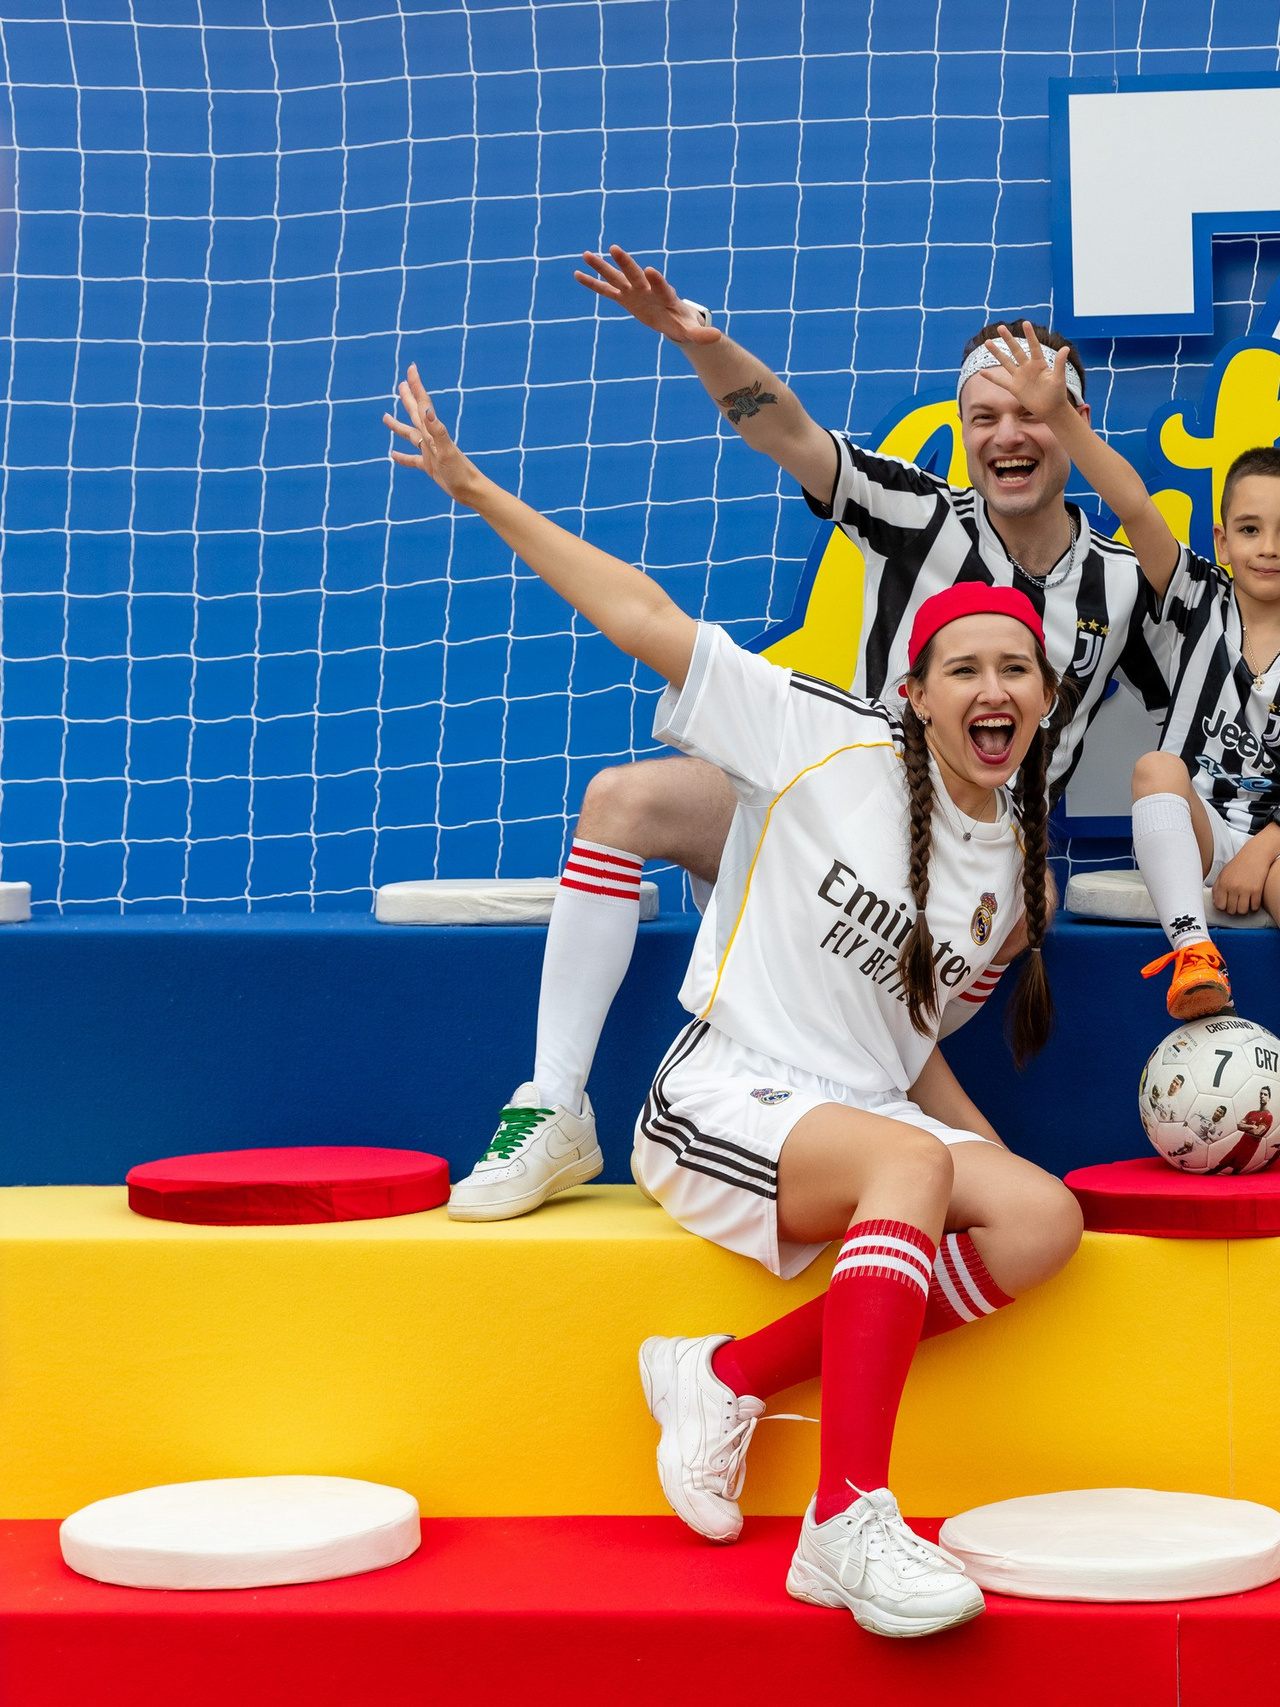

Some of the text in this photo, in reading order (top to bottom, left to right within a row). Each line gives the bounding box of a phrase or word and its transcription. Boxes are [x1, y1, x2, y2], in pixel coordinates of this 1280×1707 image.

[1202, 708, 1276, 771] Jeep
[819, 919, 870, 959] FLY
[1205, 1020, 1254, 1034] CRISTIANO
[1212, 1049, 1233, 1088] 7
[1255, 1046, 1279, 1073] CR7
